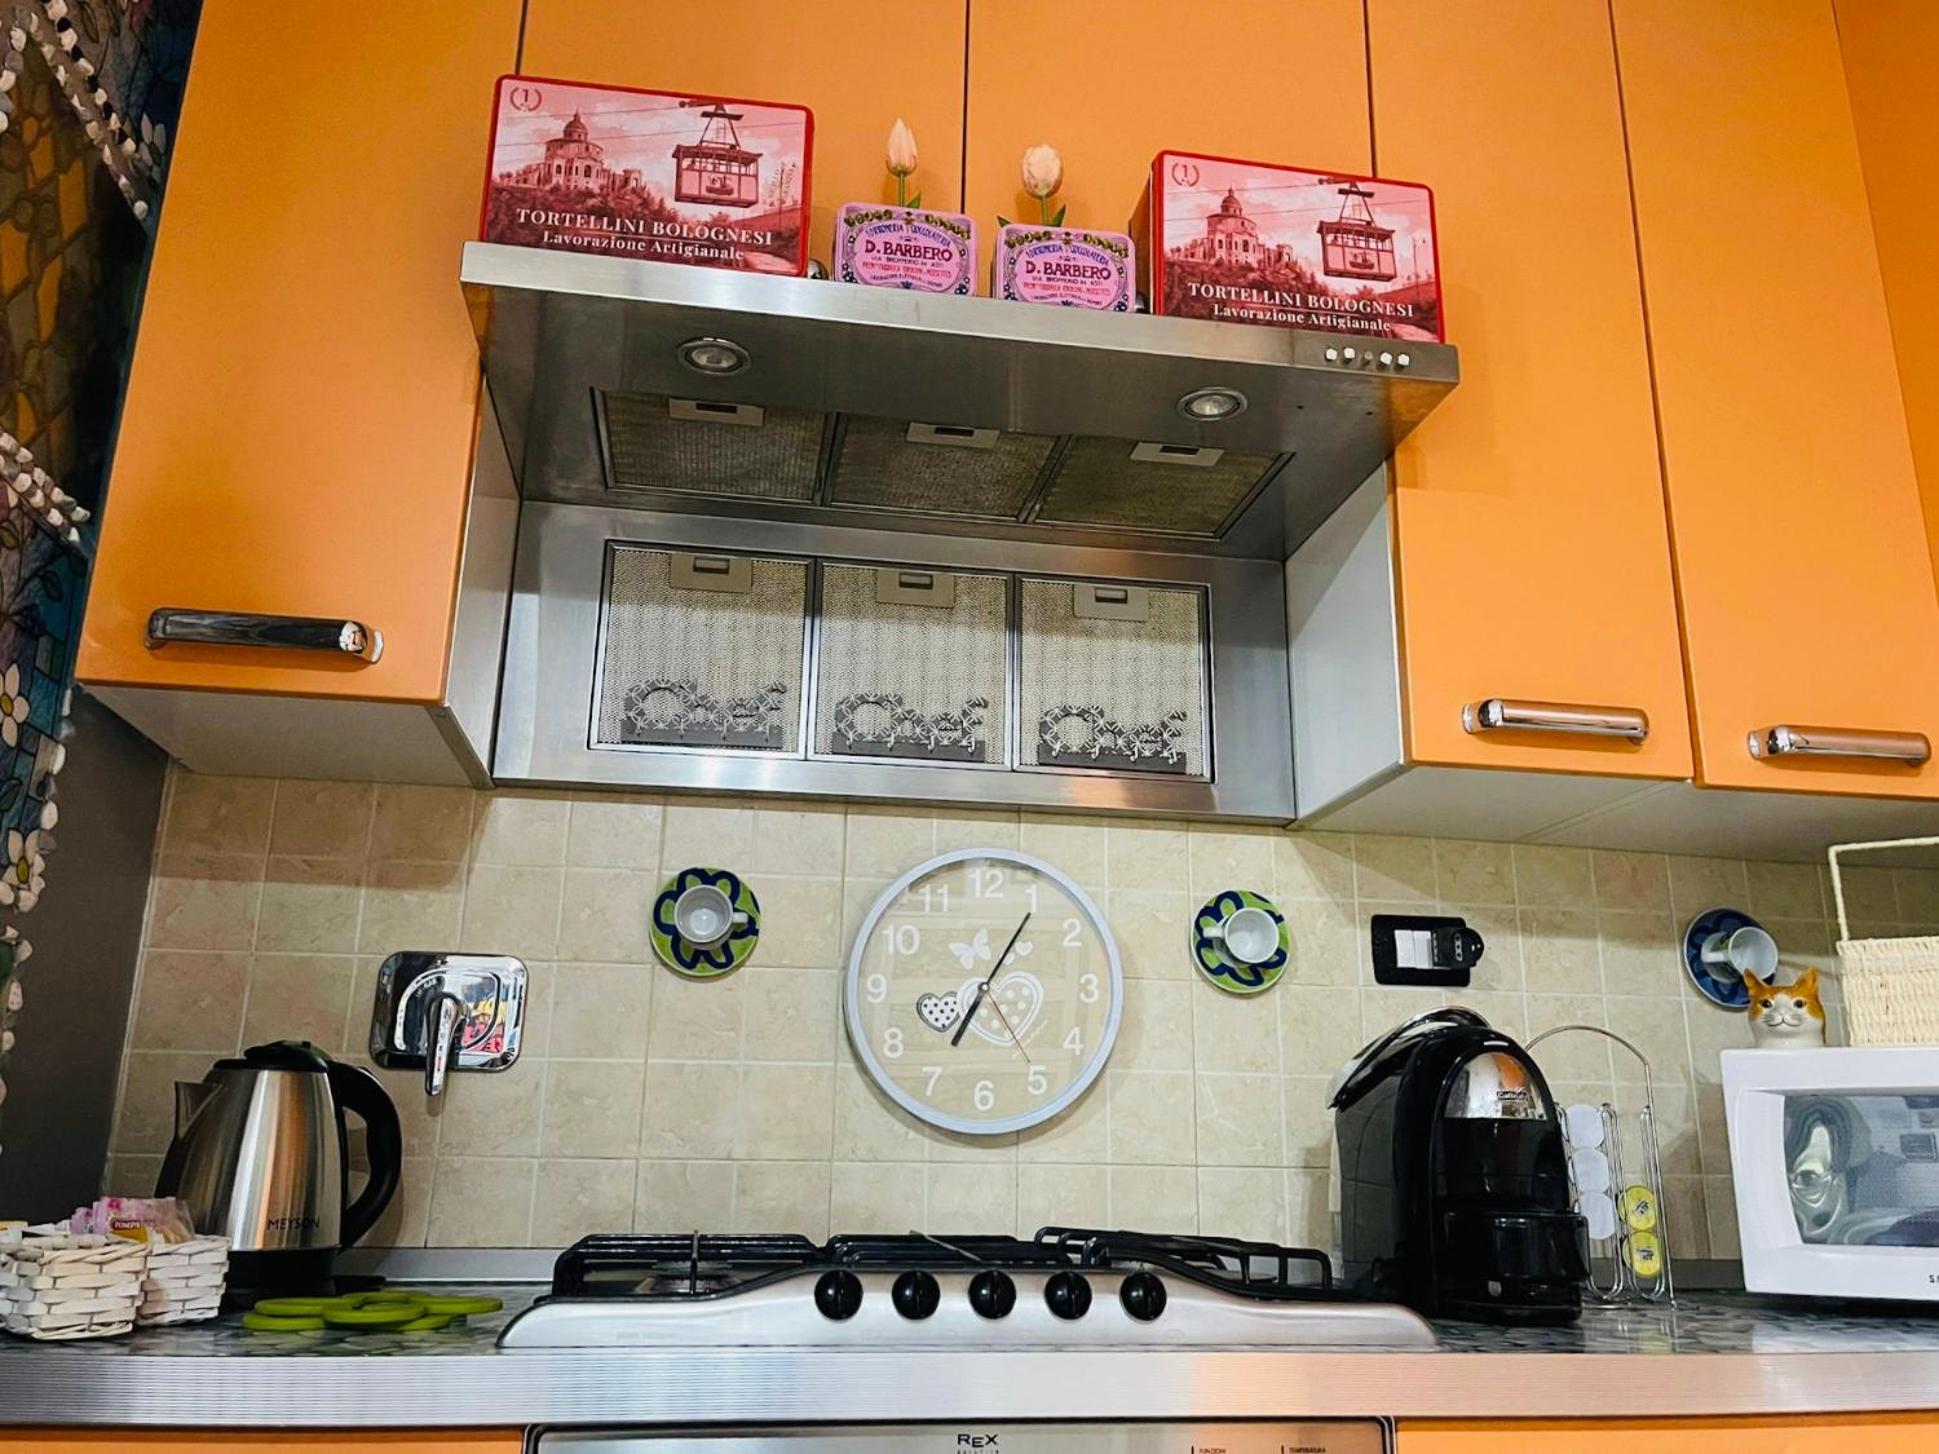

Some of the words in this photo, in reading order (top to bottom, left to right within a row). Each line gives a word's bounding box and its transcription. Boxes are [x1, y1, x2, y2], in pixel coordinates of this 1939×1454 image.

[516, 207, 645, 234] TORTELLINI
[652, 221, 773, 246] BOLOGNESI
[542, 230, 647, 252] Lavorazione
[650, 240, 744, 260] Artigianale
[865, 240, 880, 254] D.
[883, 241, 953, 262] BARBERO
[1026, 261, 1041, 274] D.
[1043, 262, 1112, 280] BARBERO
[1188, 281, 1301, 307] TORTELLINI
[1308, 294, 1414, 318] BOLOGNESI
[1214, 303, 1305, 324] Lavorazione
[1308, 311, 1391, 332] Artigianale
[919, 884, 950, 913] 11
[969, 870, 1004, 898] 12
[1025, 885, 1037, 913] 1
[883, 925, 920, 955] 10
[1062, 918, 1082, 947] 2
[866, 974, 888, 1003] 9
[1079, 974, 1100, 1003] 3
[883, 1027, 904, 1058] 8
[1062, 1026, 1084, 1056] 4
[922, 1067, 943, 1096] 7
[1027, 1065, 1047, 1094] 5
[973, 1080, 995, 1111] 6
[267, 1217, 320, 1230] MEYSON
[957, 1433, 998, 1448] REX
